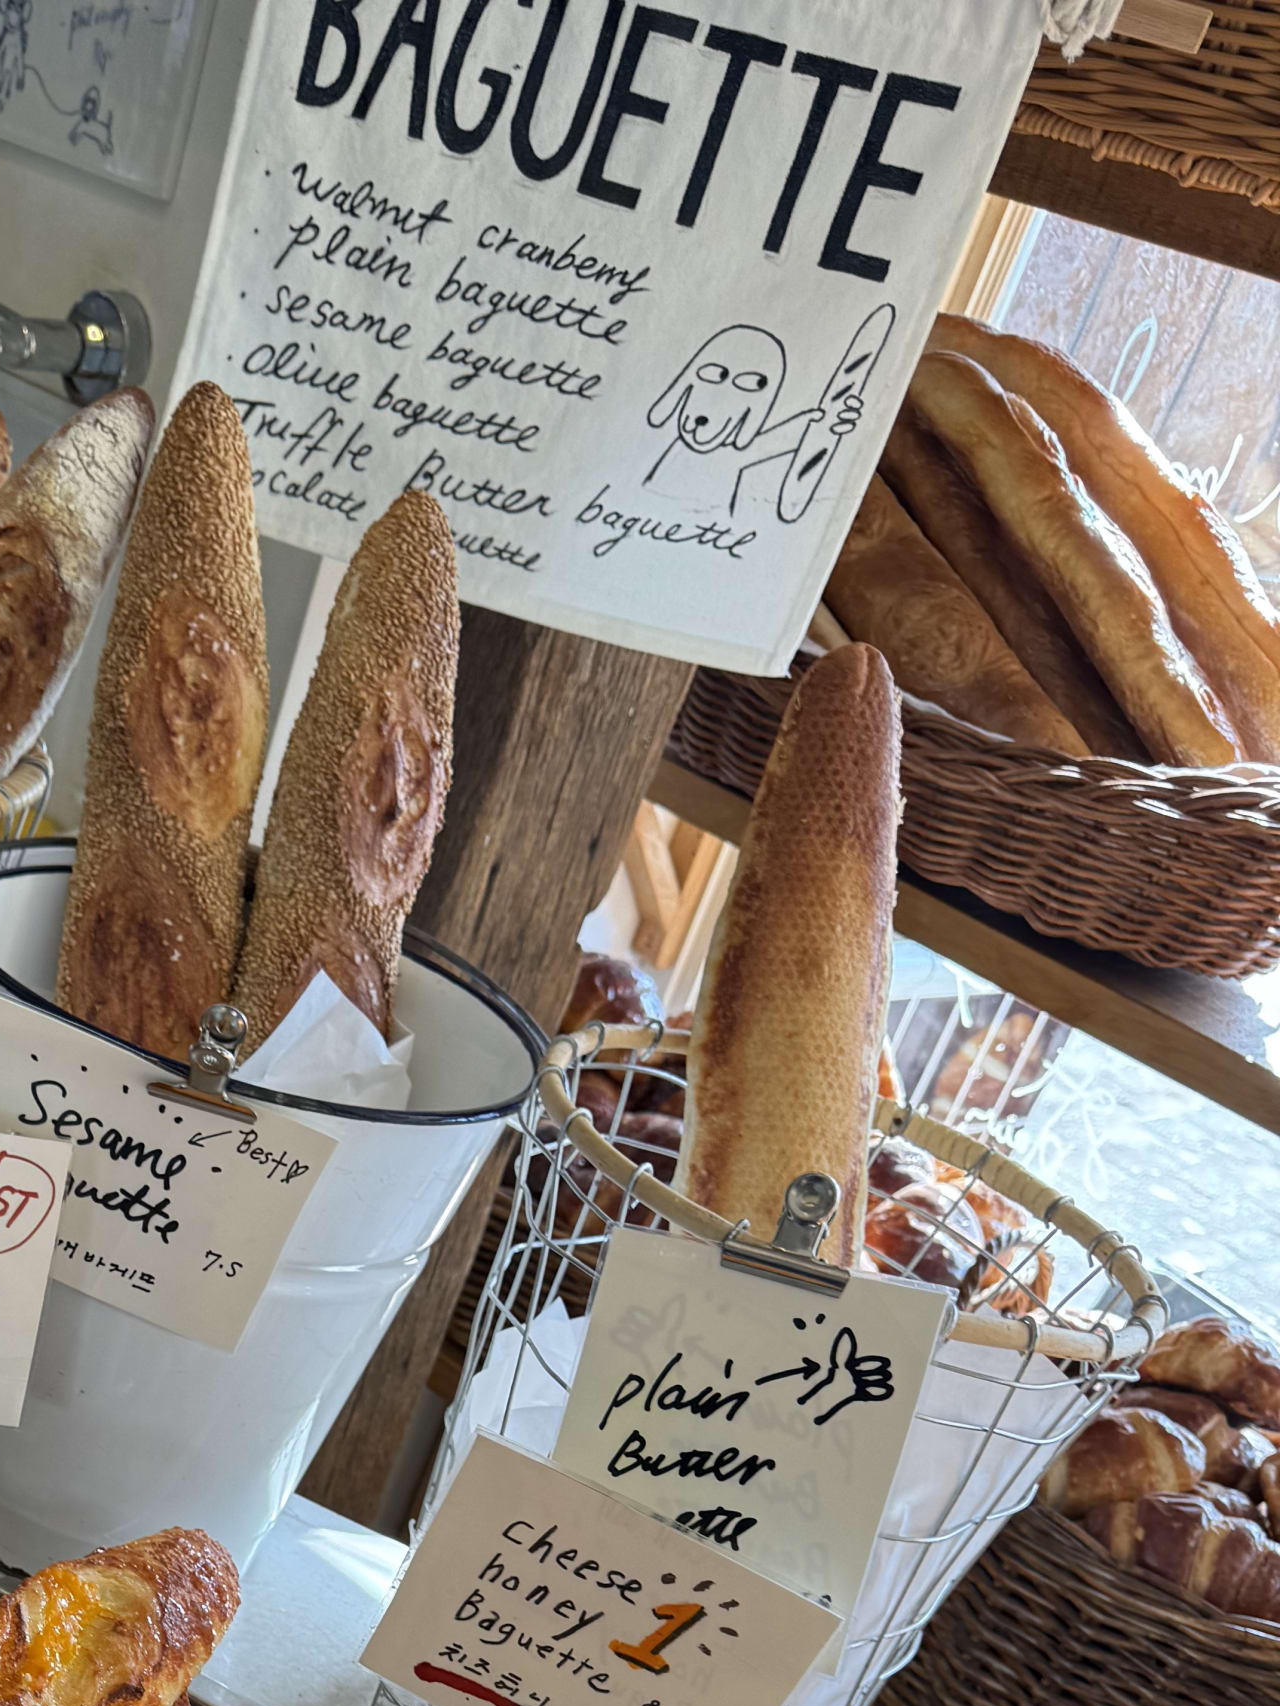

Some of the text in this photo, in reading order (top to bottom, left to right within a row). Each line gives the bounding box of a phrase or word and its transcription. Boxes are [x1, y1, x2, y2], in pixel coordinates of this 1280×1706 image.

[295, 0, 962, 283] BAGUETTE
[273, 215, 632, 346] plain baguette
[476, 223, 651, 305] cranberry
[266, 284, 605, 400] sesame baguette
[373, 373, 541, 454] baguette
[232, 397, 758, 560] Truffle Butter baguette
[451, 527, 543, 575] uette
[18, 1079, 188, 1192] Sesame
[66, 1173, 180, 1245] uette
[202, 1249, 244, 1278] 7.5
[607, 1429, 776, 1486] Butter
[478, 1552, 606, 1642] honey
[608, 1602, 709, 1675] 1
[454, 1588, 612, 1696] Baguette
